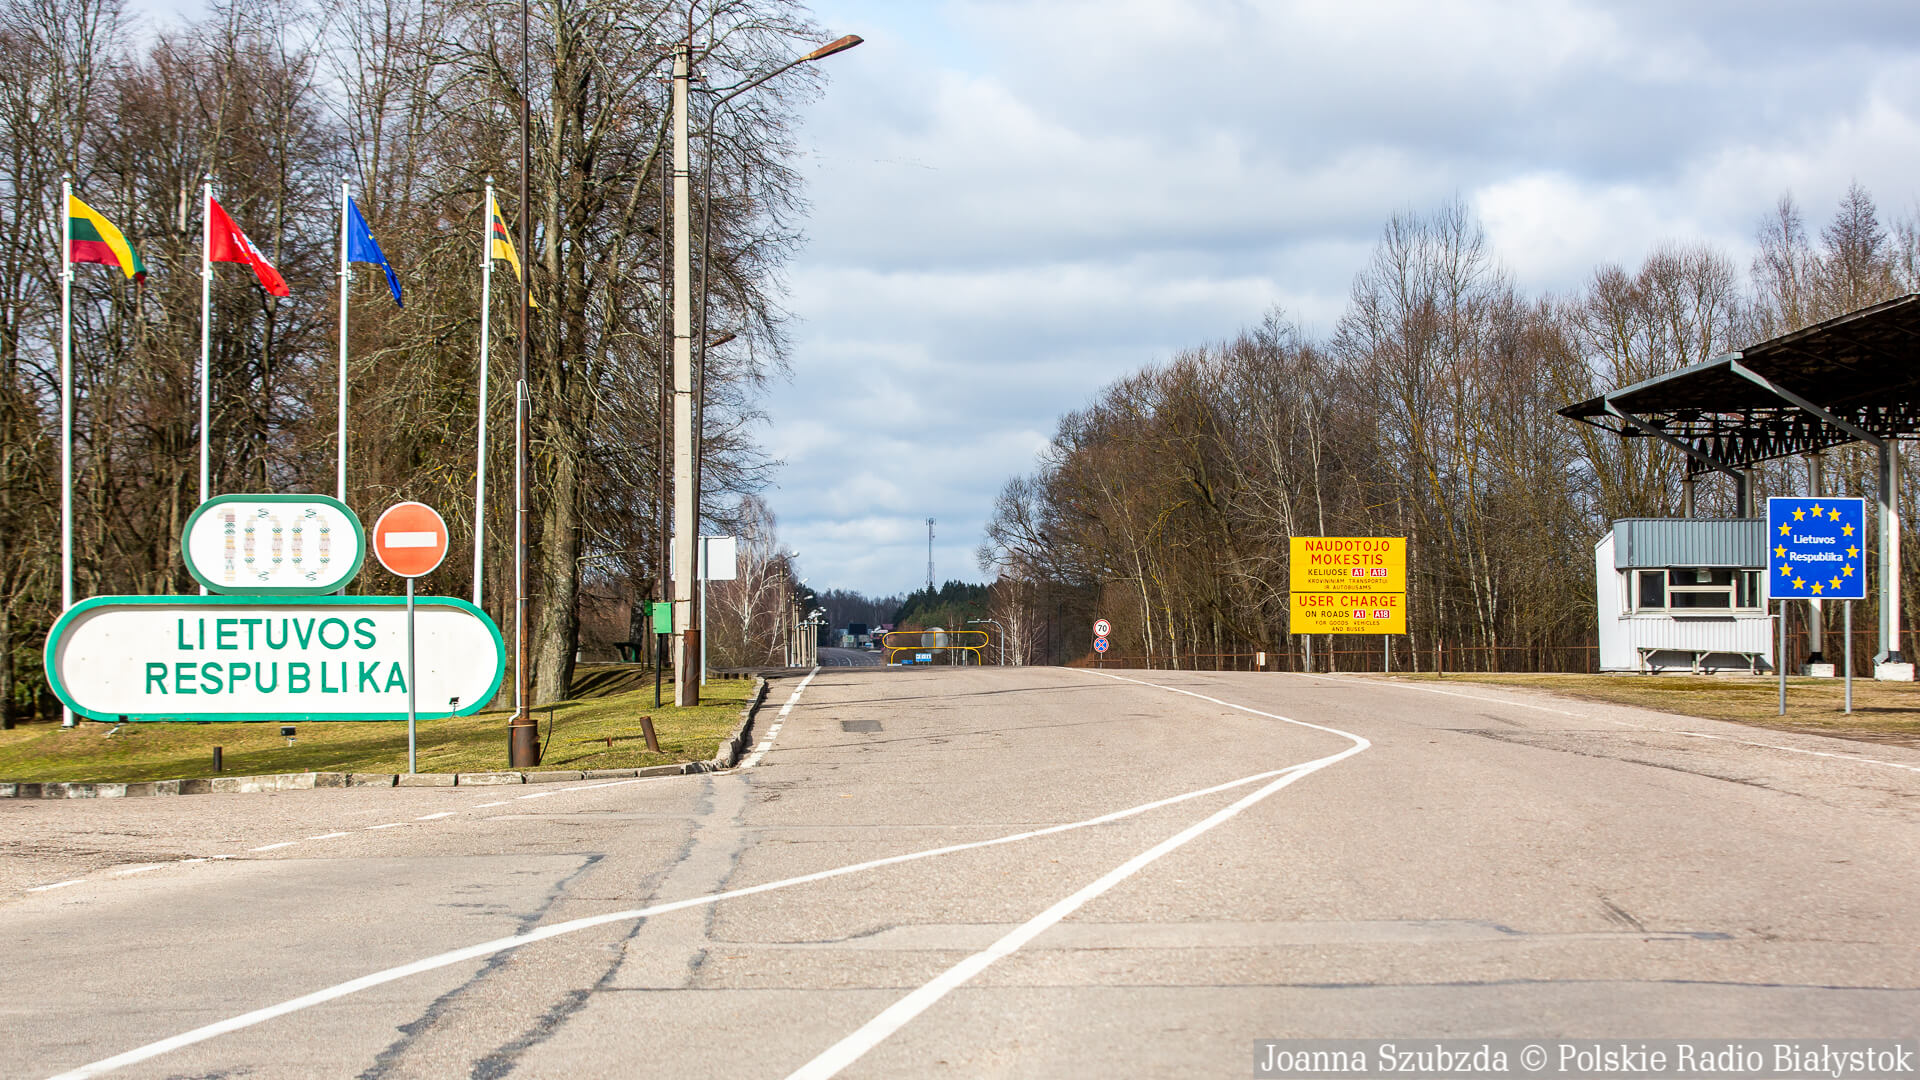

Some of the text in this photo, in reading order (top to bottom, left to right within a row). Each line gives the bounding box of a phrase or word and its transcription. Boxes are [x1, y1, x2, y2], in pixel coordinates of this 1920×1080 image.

[217, 508, 331, 582] 100
[1793, 534, 1836, 545] Lietuvos
[1305, 540, 1390, 552] NAUDOTOJO
[1311, 553, 1383, 565] MOKESTIS
[1789, 551, 1844, 564] Respublika
[1307, 568, 1348, 576] KELIUOSE
[1353, 568, 1363, 577] A1
[1371, 568, 1387, 577] A18
[1299, 595, 1397, 607] USER CHARGE
[1305, 610, 1317, 618] ON
[1321, 610, 1350, 618] ROADS
[1355, 610, 1365, 618] A1
[1374, 610, 1389, 618] A18
[177, 617, 377, 651] LIETUVOS
[1098, 624, 1107, 632] 70
[145, 660, 408, 695] RESPUBLIKA
